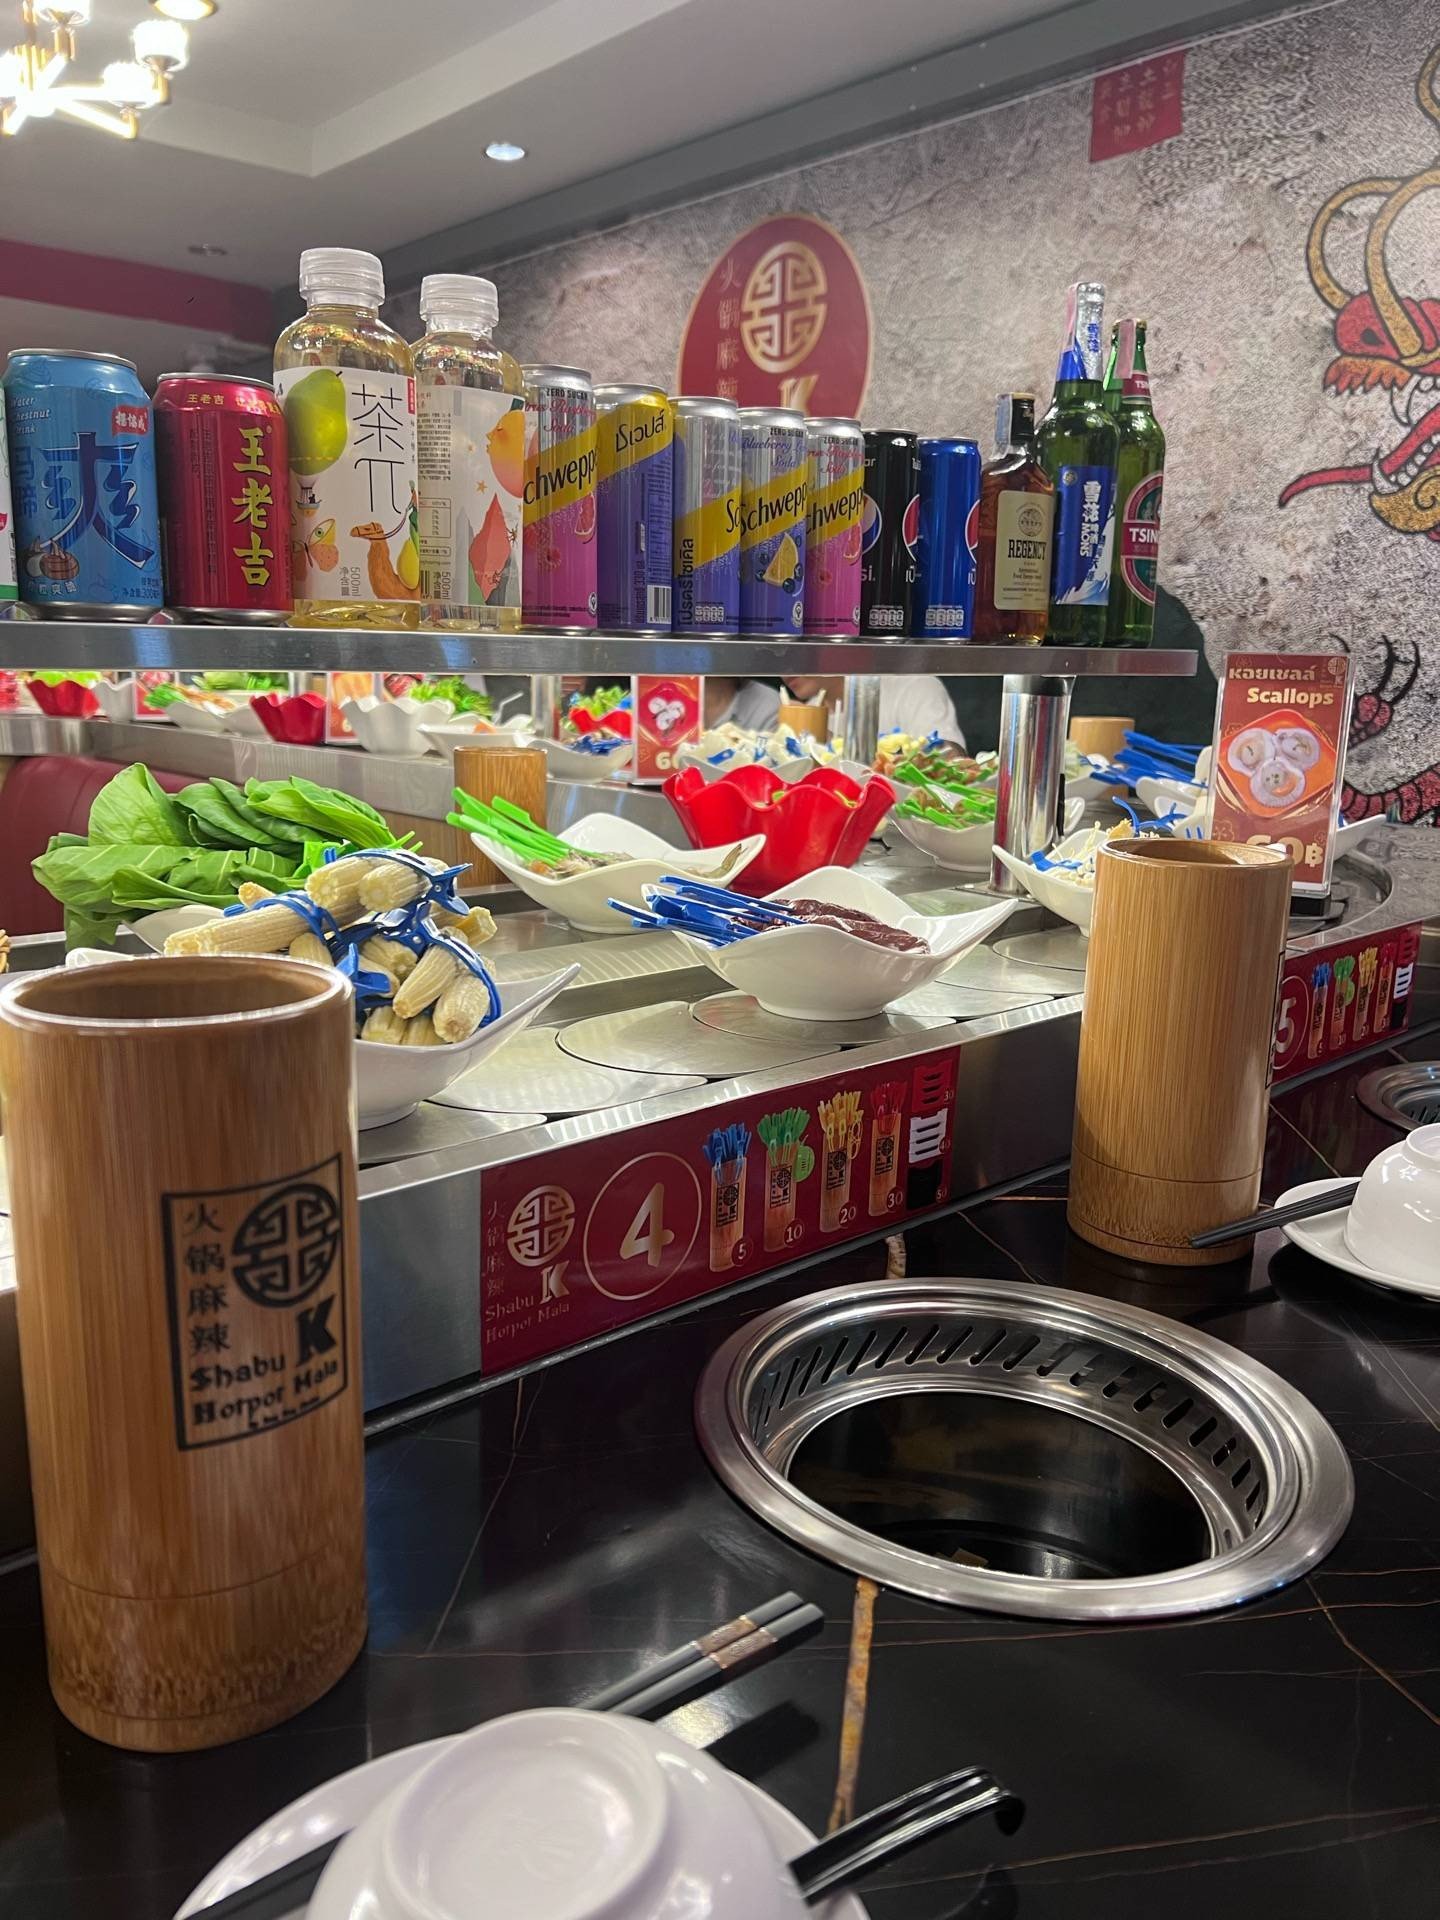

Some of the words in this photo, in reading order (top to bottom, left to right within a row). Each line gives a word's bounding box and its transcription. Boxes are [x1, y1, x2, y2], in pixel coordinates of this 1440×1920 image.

[186, 393, 224, 405] 王老吉
[545, 387, 565, 398] ZERO
[15, 409, 50, 420] hestnut
[40, 431, 155, 569] 爽
[231, 426, 274, 586] 王老吉
[1008, 539, 1047, 560] REGENCY
[351, 566, 361, 597] 500ml
[1228, 664, 1317, 681] หอยเชลล์
[1246, 687, 1334, 708] Scallops
[1275, 996, 1297, 1054] 5
[886, 1190, 904, 1209] 30
[619, 1182, 675, 1268] 4
[838, 1205, 857, 1225] 20
[785, 1223, 804, 1244] 10
[737, 1242, 747, 1260] 5
[539, 1260, 571, 1304] K
[485, 1294, 535, 1322] Shabu
[538, 1303, 570, 1324] Mala
[297, 1294, 338, 1367] K
[190, 1353, 286, 1392] Shabu
[294, 1359, 338, 1394] Mala
